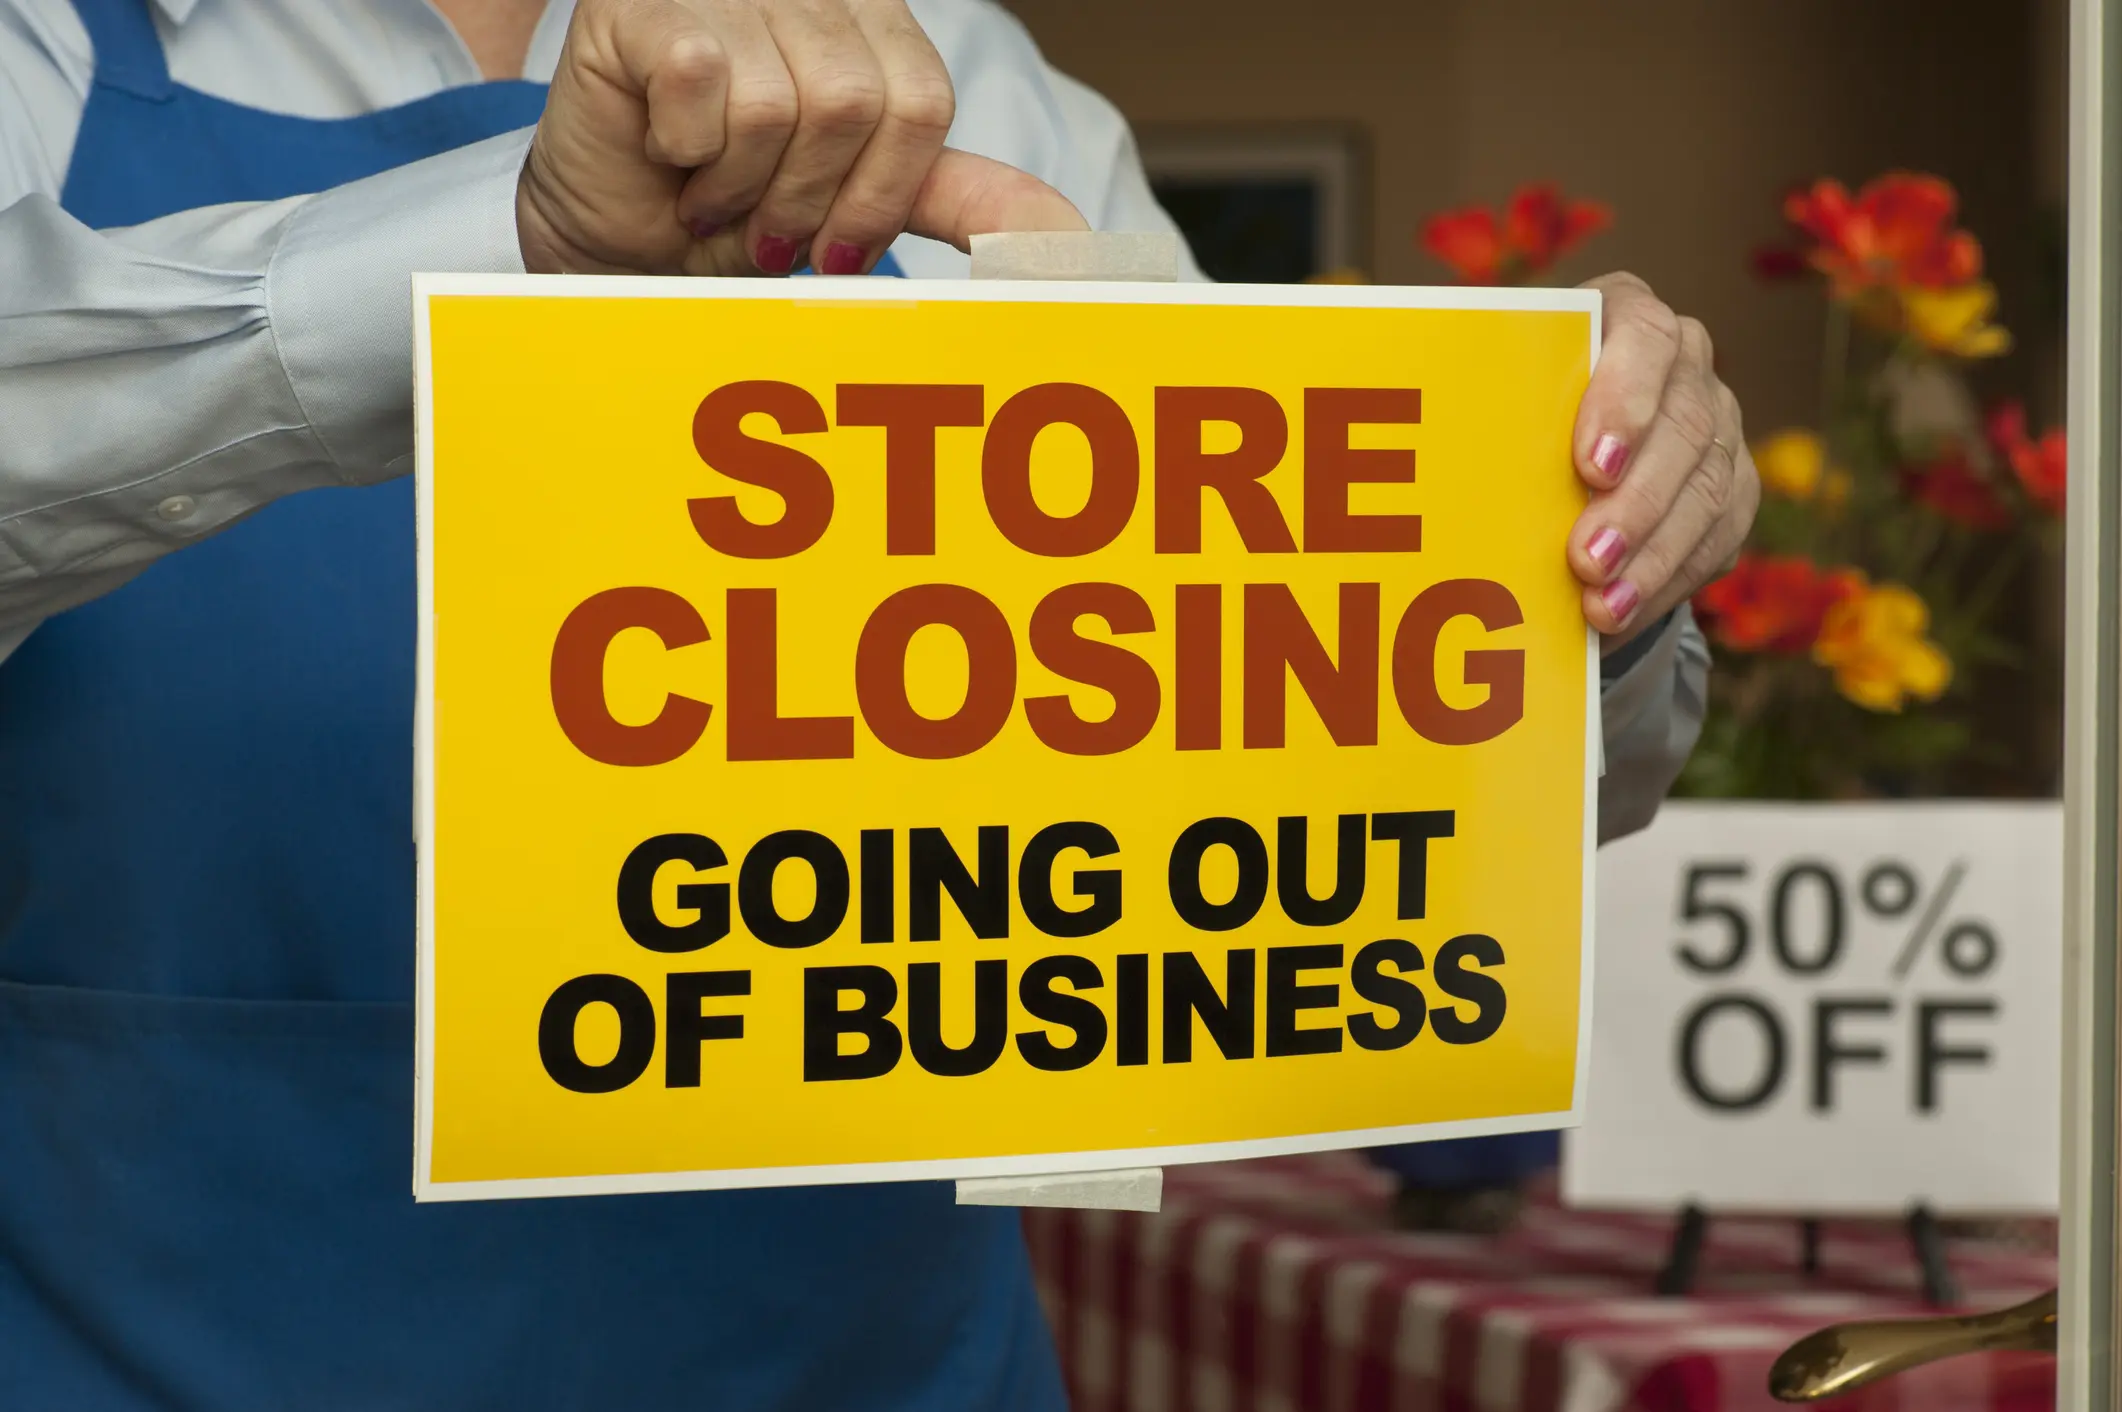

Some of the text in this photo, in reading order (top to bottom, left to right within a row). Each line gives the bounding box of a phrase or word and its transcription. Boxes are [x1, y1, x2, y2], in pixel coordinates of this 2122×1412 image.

[687, 380, 1423, 560] STORE
[549, 578, 1526, 768] CLOSING
[616, 809, 1456, 954] GOING OUT
[1674, 858, 1999, 979] 50%
[537, 933, 1507, 1094] OF BUSINESS
[1673, 990, 2000, 1117] OFF
